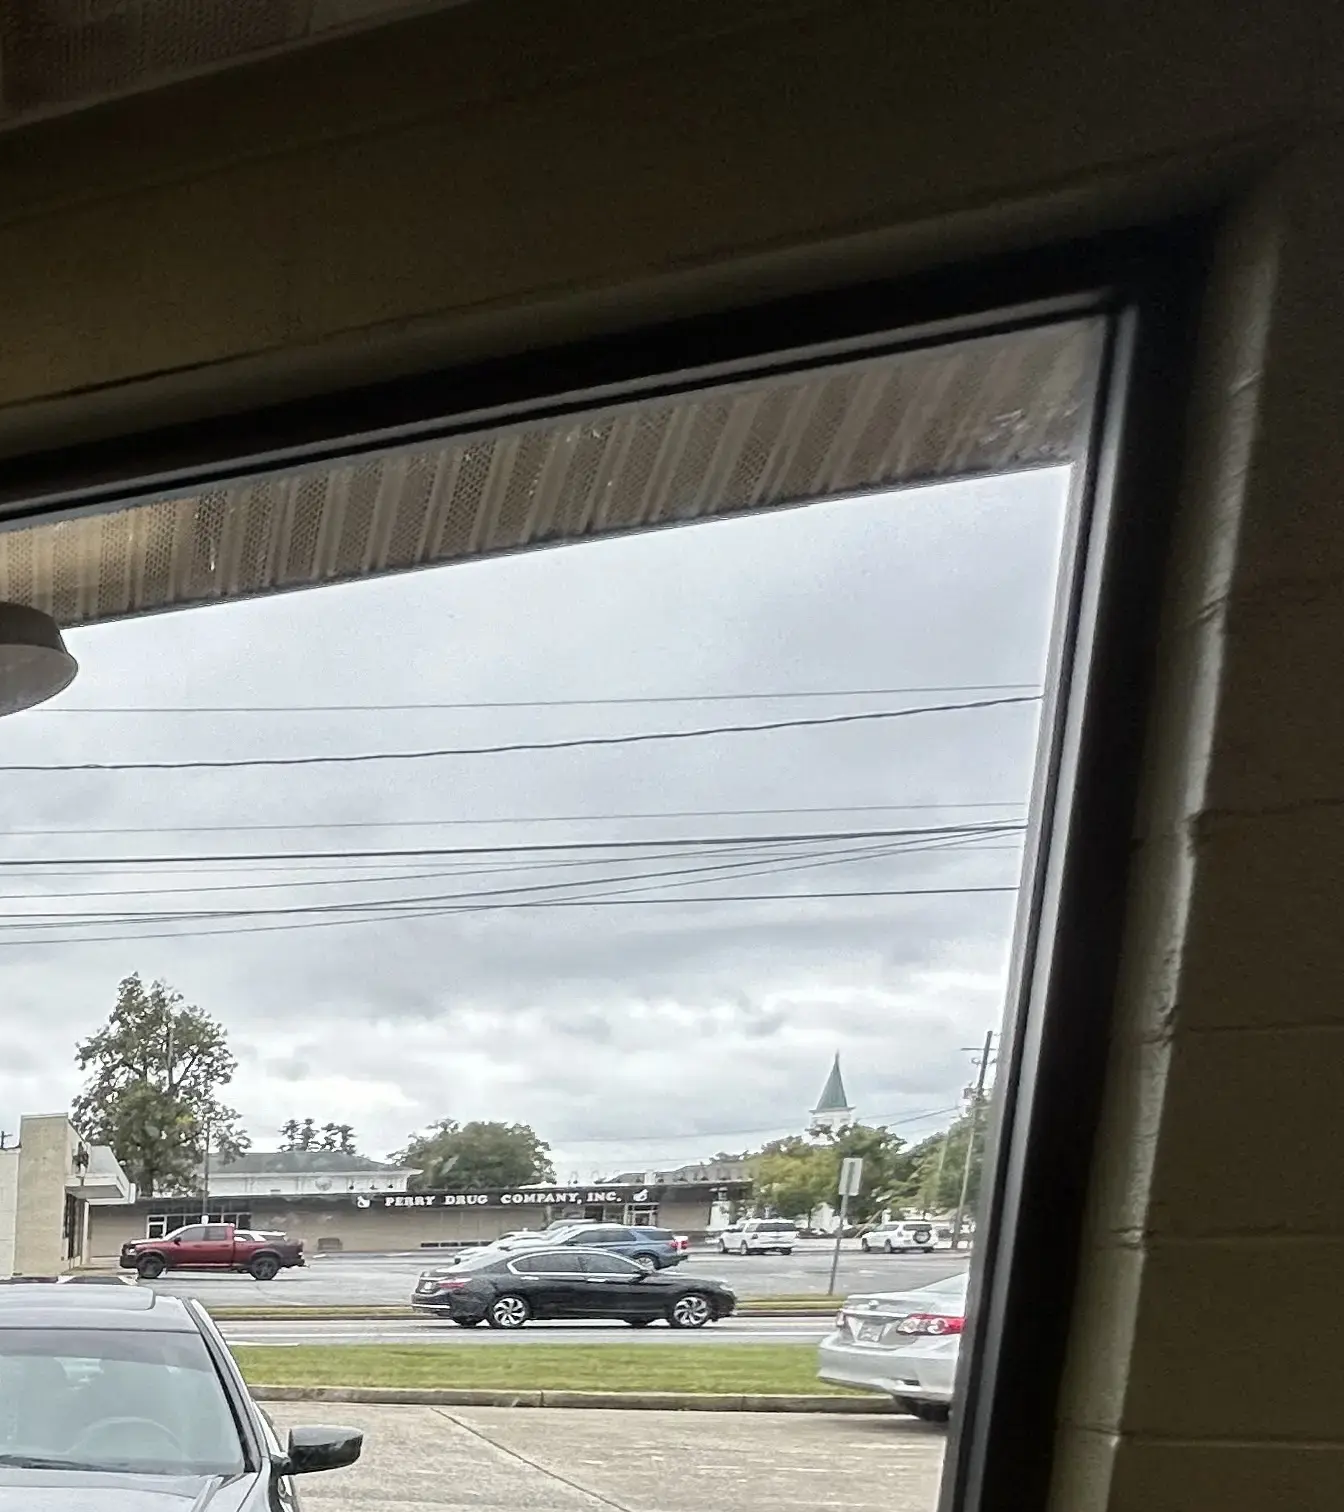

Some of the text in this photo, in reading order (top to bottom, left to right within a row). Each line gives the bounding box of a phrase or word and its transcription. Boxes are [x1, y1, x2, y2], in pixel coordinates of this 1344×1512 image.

[384, 1191, 622, 1207] PERRY DRUG COMPANY, INC.
